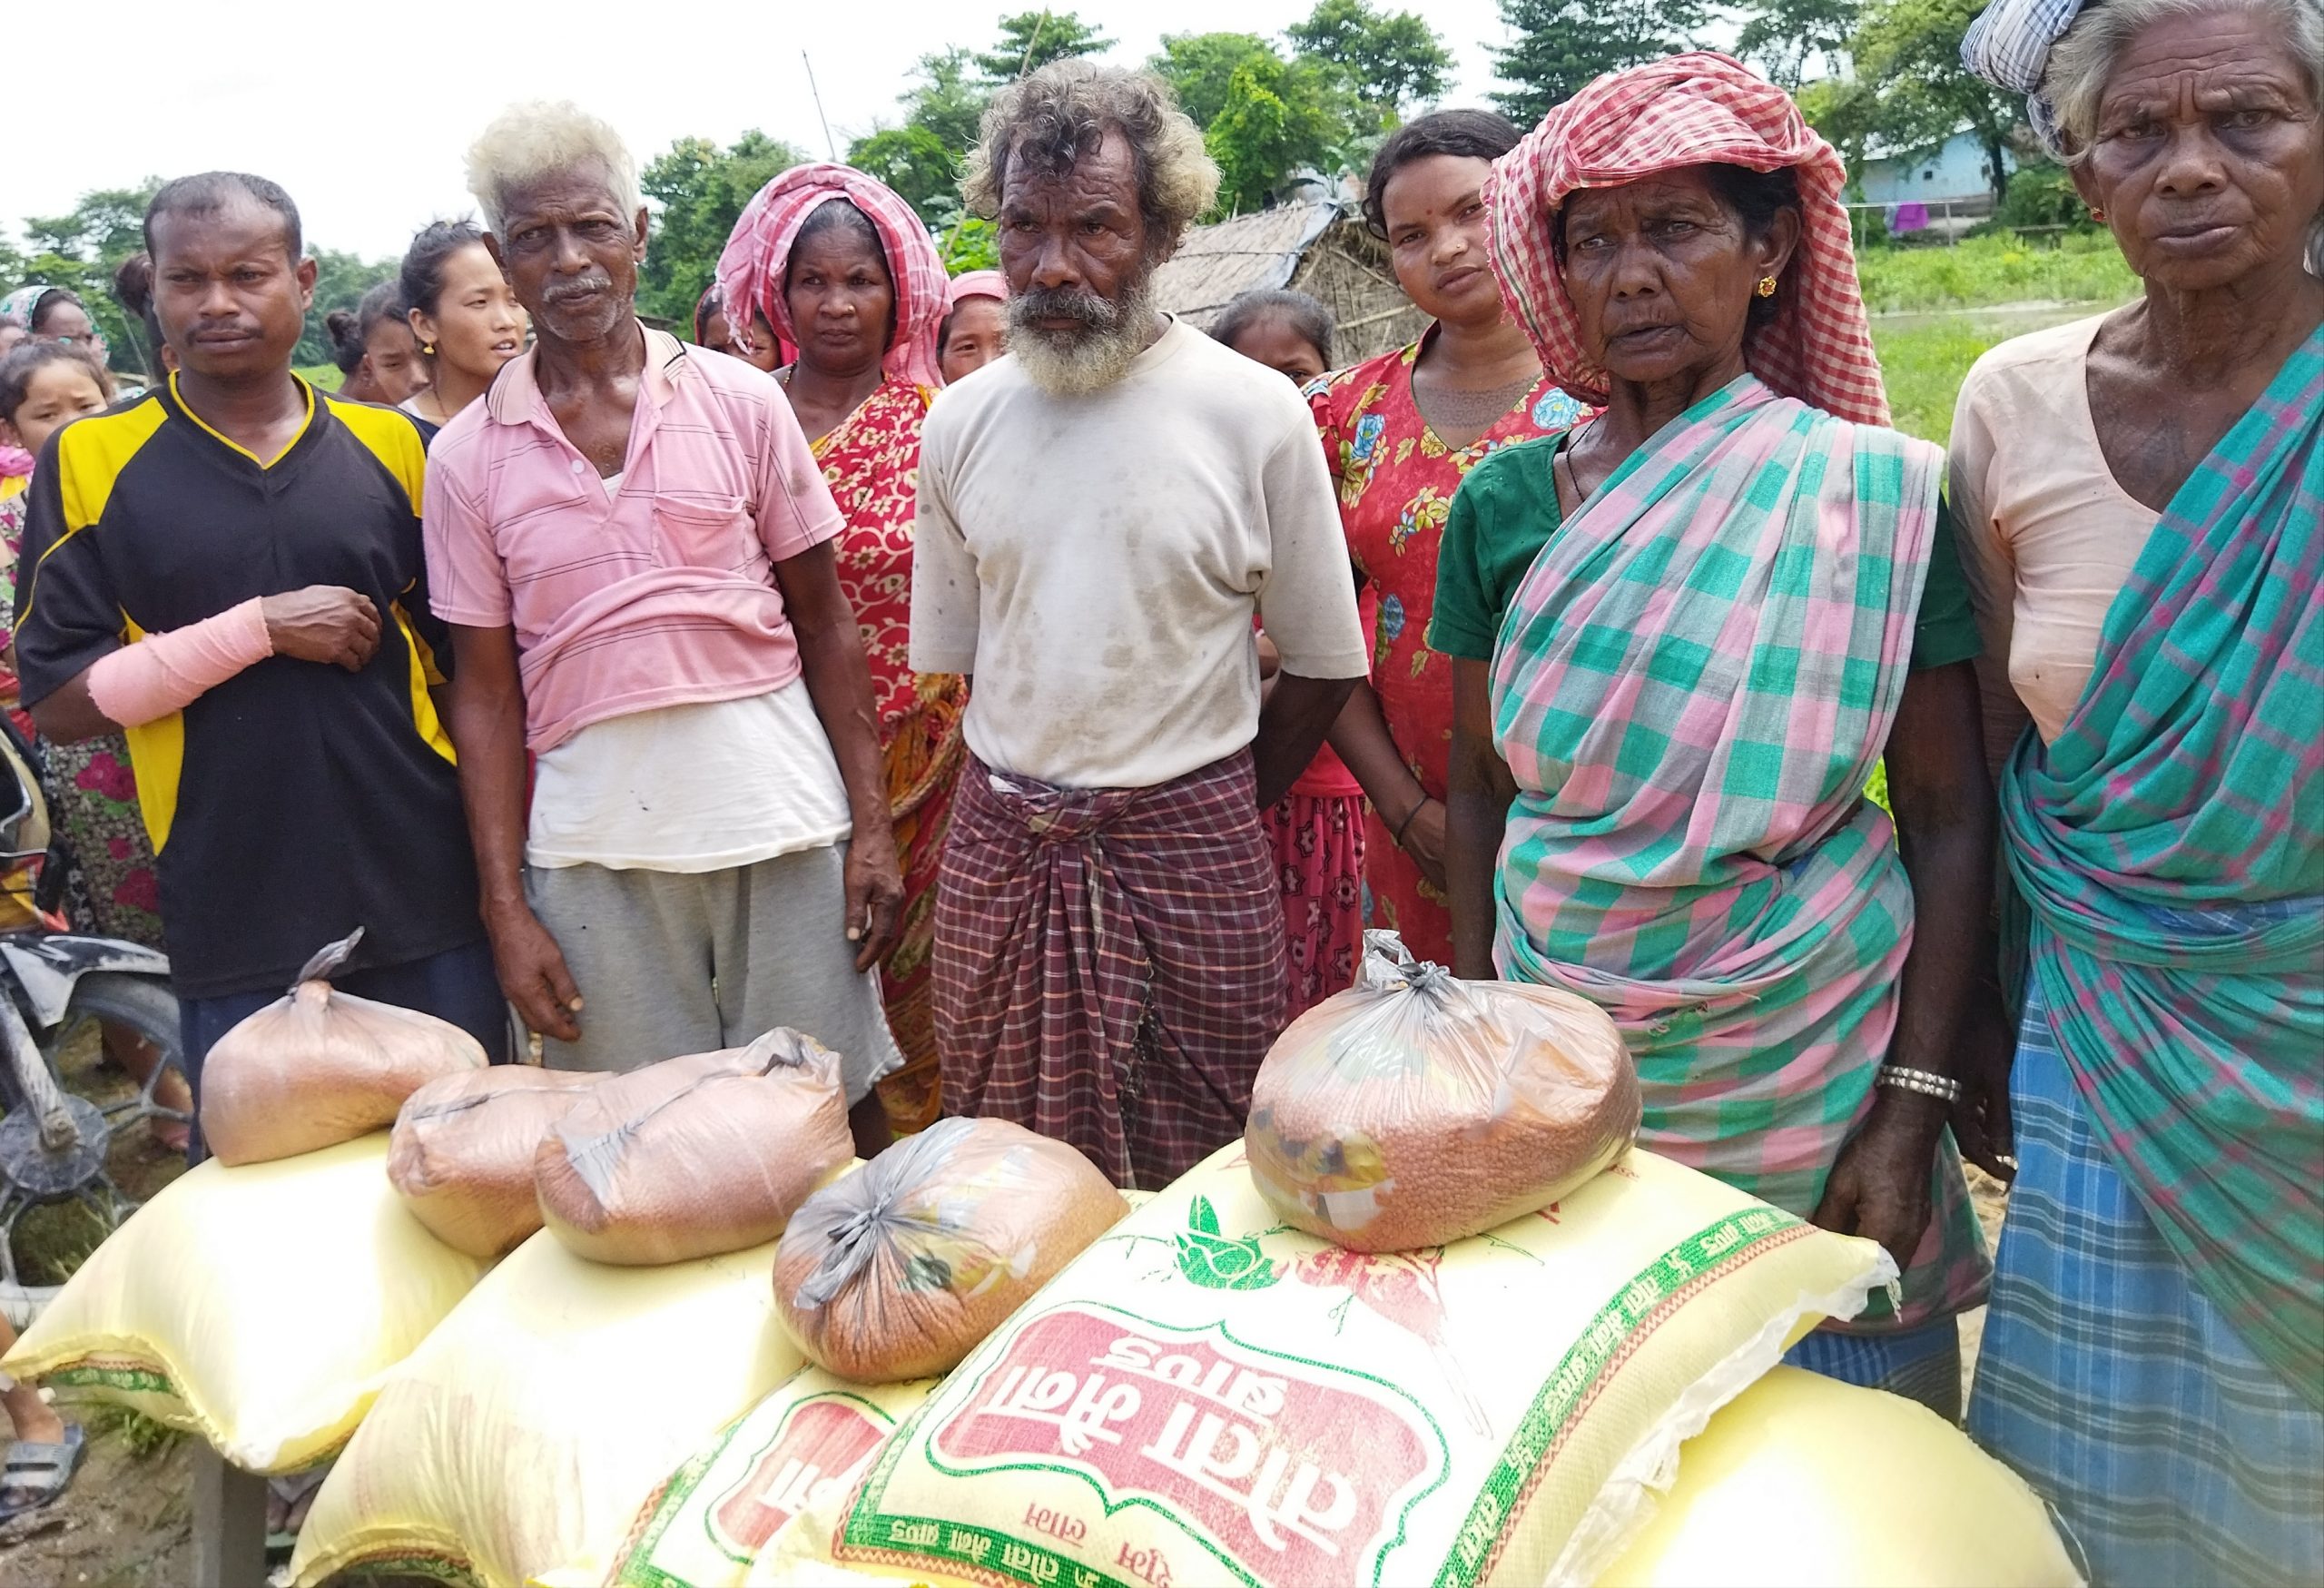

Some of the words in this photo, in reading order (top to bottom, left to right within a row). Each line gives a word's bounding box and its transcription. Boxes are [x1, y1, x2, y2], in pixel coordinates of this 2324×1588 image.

[976, 1365, 1142, 1455] मैना
[1141, 1401, 1358, 1556] तोता
[948, 1529, 992, 1563] मैना
[1020, 1501, 1088, 1549] लाभ
[1001, 1544, 1060, 1586] तोता
